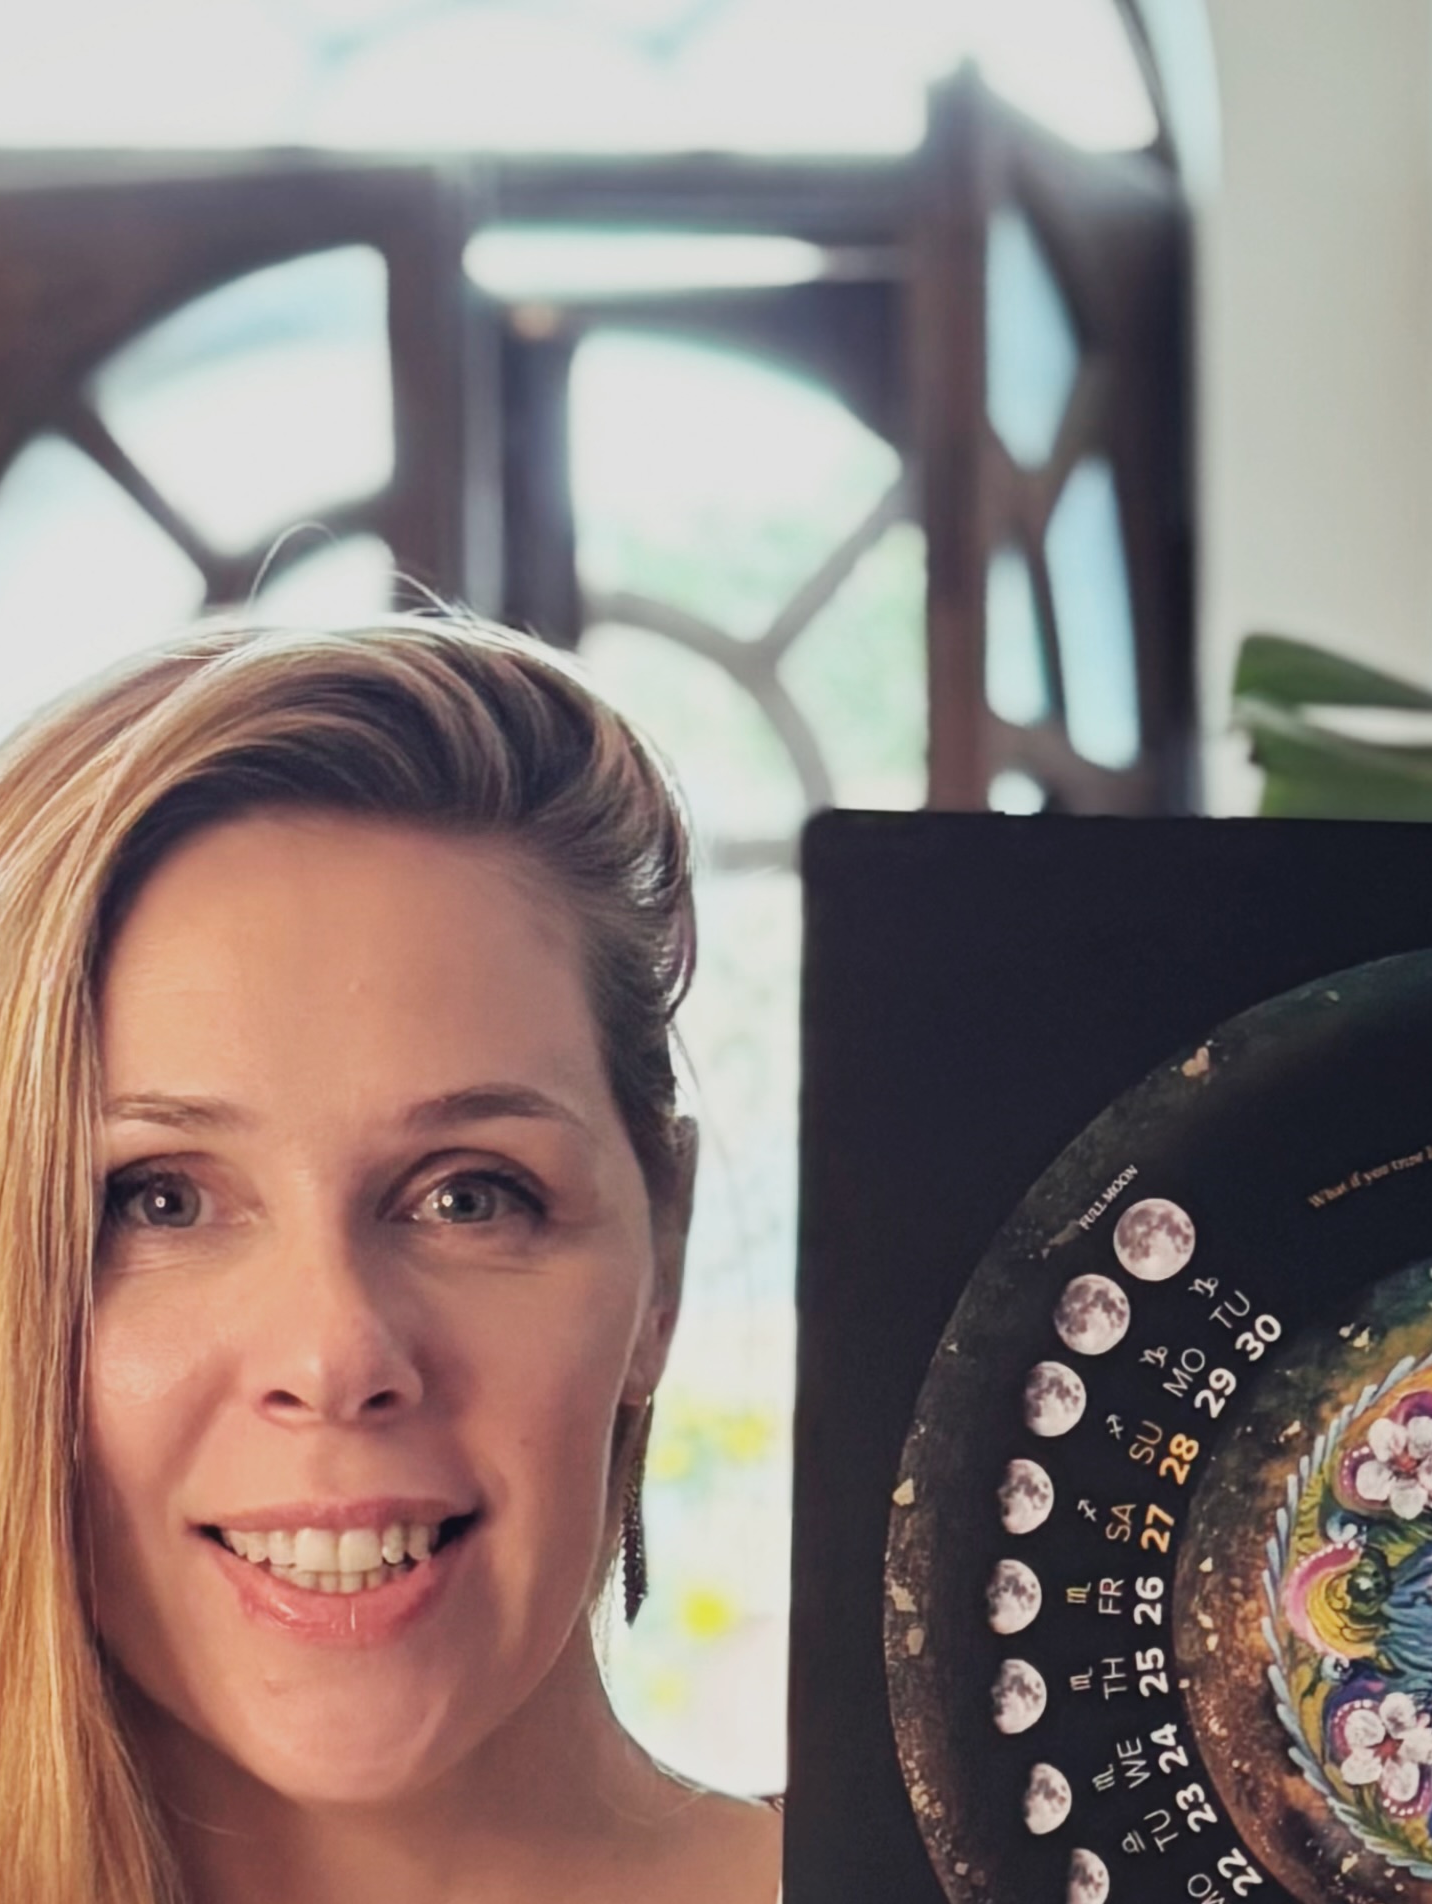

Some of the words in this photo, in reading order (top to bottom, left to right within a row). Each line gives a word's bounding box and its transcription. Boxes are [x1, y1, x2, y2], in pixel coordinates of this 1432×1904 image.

[1101, 1164, 1139, 1203] MOON
[1208, 1290, 1251, 1329] TU
[1234, 1314, 1282, 1362] 30
[1162, 1347, 1206, 1398] MO
[1193, 1367, 1237, 1419] 29
[1129, 1420, 1163, 1465] SU
[1159, 1433, 1200, 1486] 28
[1105, 1503, 1138, 1543] SA
[1140, 1503, 1175, 1553] 27
[1098, 1577, 1124, 1615] FR
[1133, 1575, 1165, 1626] 26
[1101, 1657, 1128, 1701] TH
[1135, 1647, 1169, 1698] 25
[1116, 1736, 1151, 1789] WE
[1149, 1723, 1190, 1775] 24
[1143, 1808, 1179, 1853] TU
[1175, 1782, 1218, 1832] 23
[1217, 1847, 1263, 1897] 22
